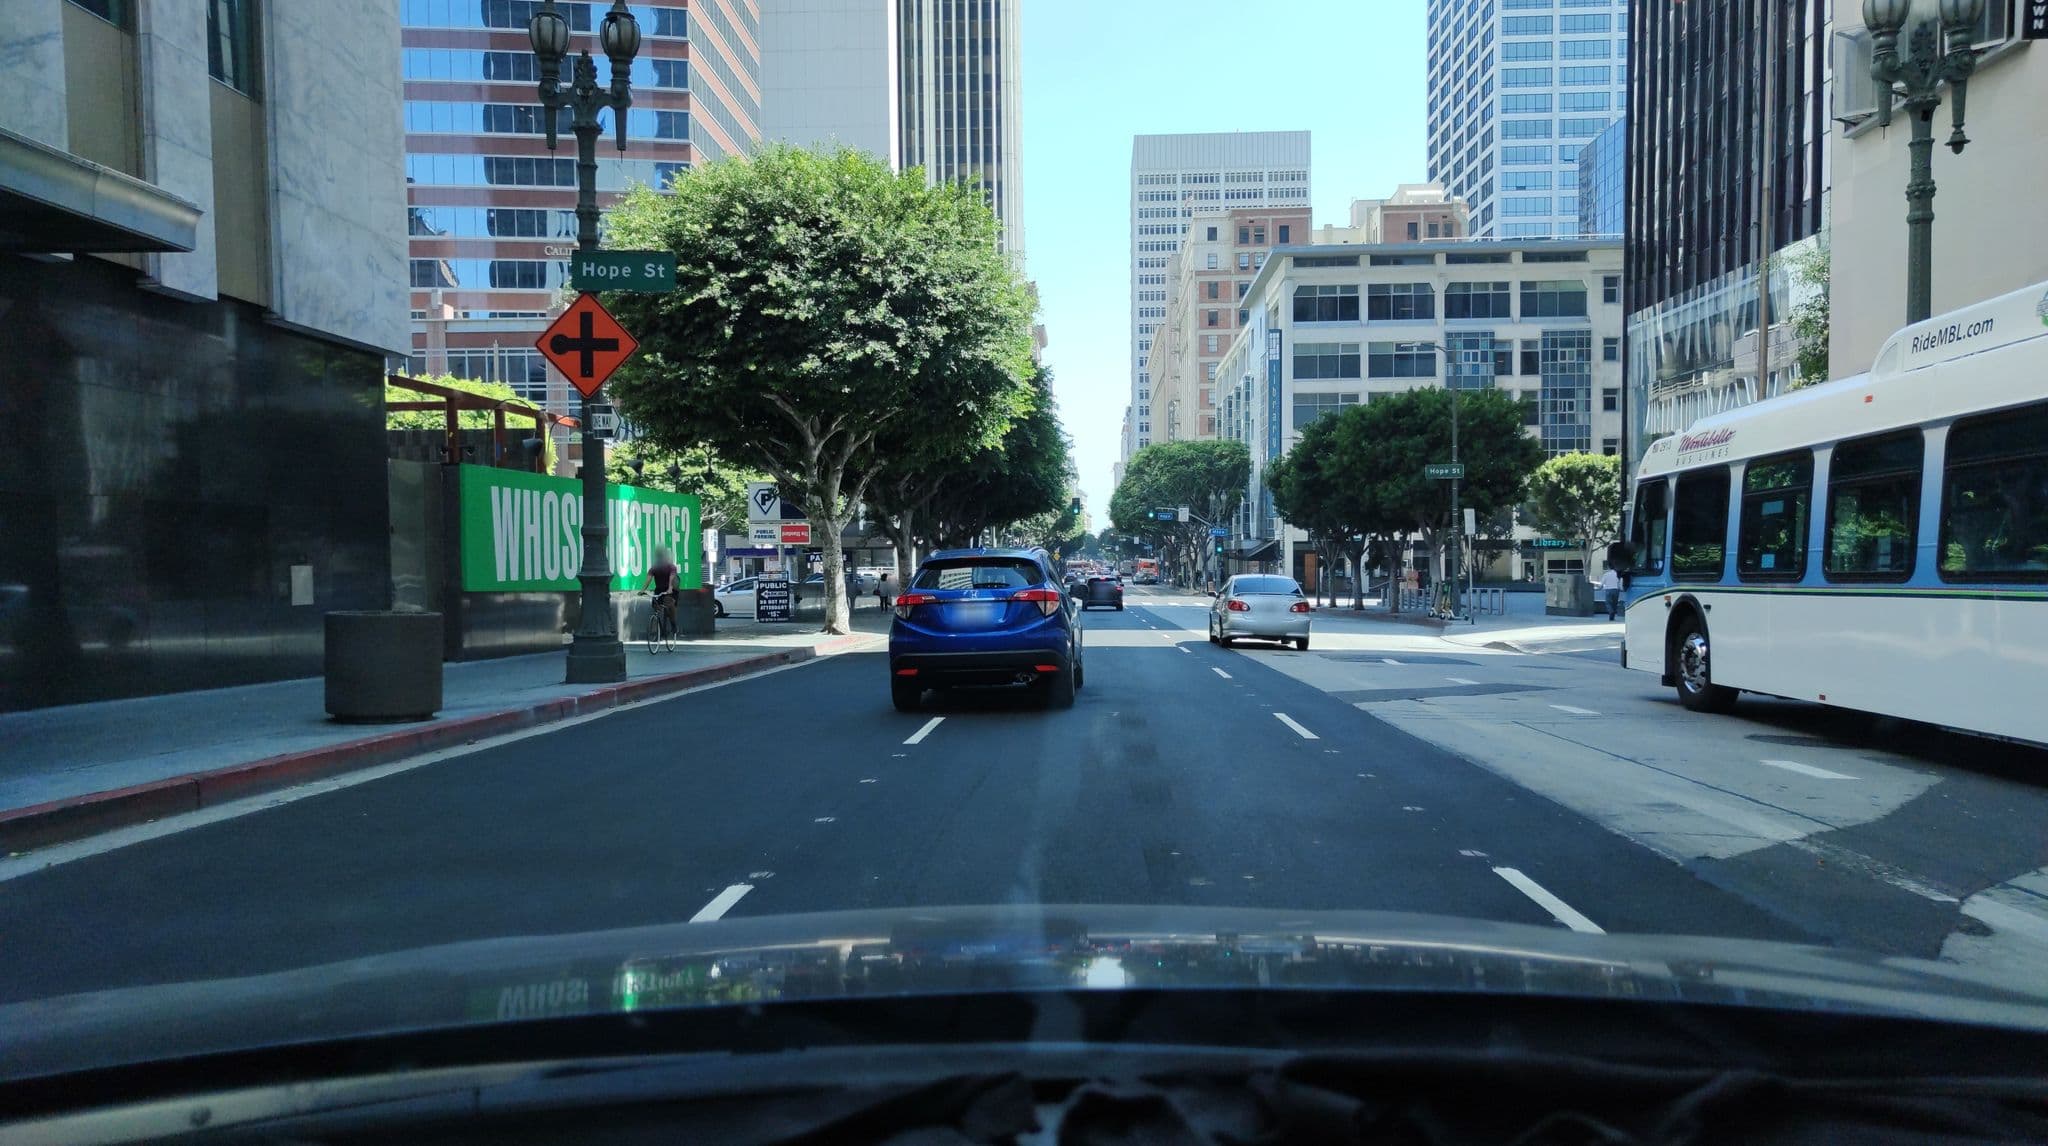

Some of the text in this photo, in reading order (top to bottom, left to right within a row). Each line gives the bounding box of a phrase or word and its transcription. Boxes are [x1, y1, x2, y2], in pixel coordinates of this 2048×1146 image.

[2033, 0, 2046, 30] WN
[582, 262, 665, 279] Hope St
[1911, 317, 1994, 354] RideMBL.com
[1678, 427, 1736, 453] Montebello
[1675, 447, 1729, 467] BUS LINES
[1430, 467, 1449, 476] Hope
[491, 485, 691, 582] WHOS JUSTICE?
[1532, 537, 1567, 548] Library
